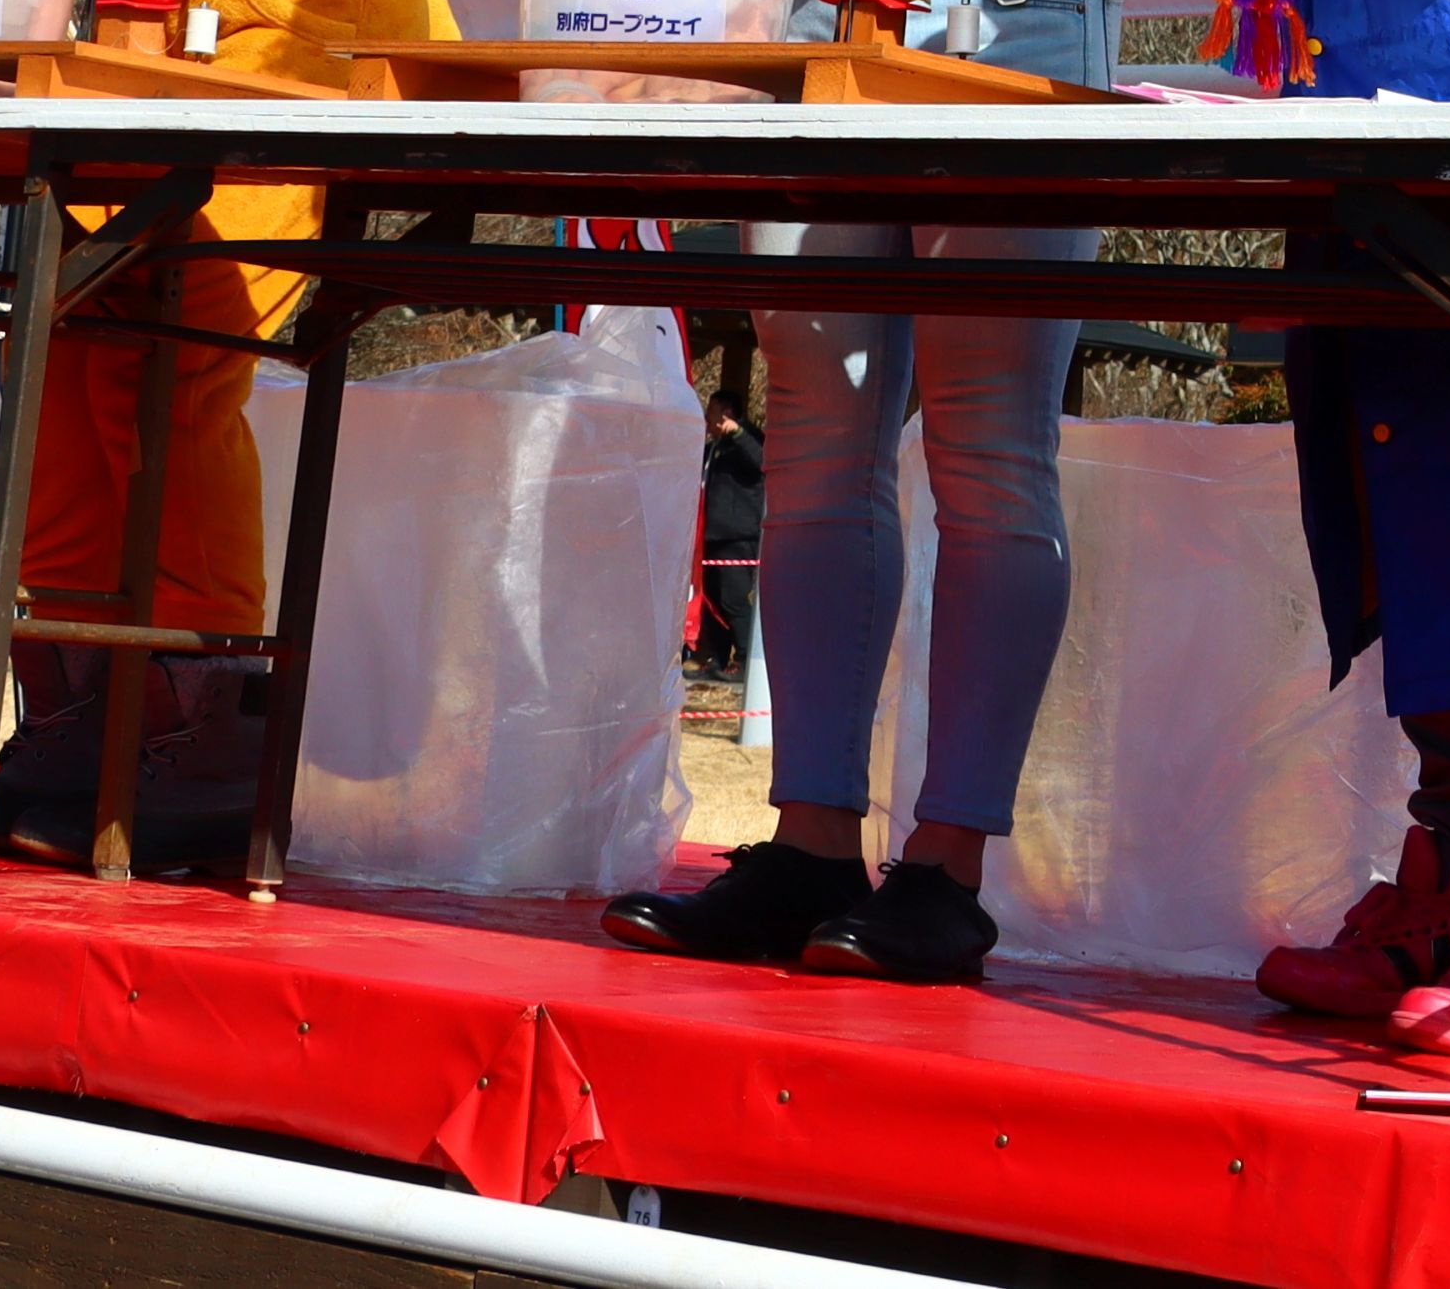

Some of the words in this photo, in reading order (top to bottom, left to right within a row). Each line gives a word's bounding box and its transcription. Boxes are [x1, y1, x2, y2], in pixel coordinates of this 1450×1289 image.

[556, 11, 702, 36] 別府ロープウェイ
